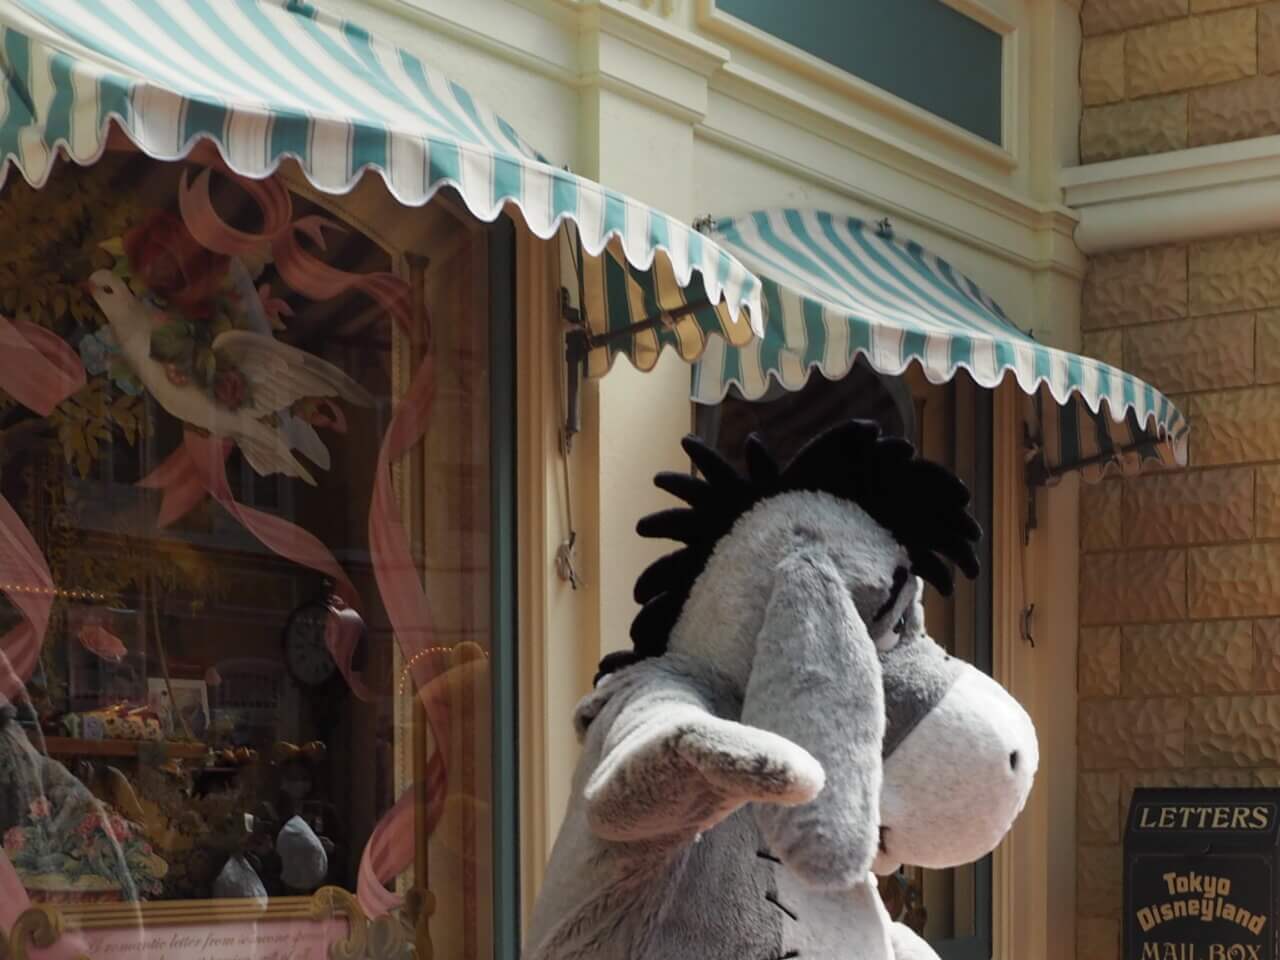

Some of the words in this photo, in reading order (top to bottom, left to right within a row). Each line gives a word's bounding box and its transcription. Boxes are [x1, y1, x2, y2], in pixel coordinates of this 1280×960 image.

[1139, 806, 1269, 829] LETTERS
[1163, 871, 1231, 898] Tokyo
[1136, 897, 1267, 935] Disneyland
